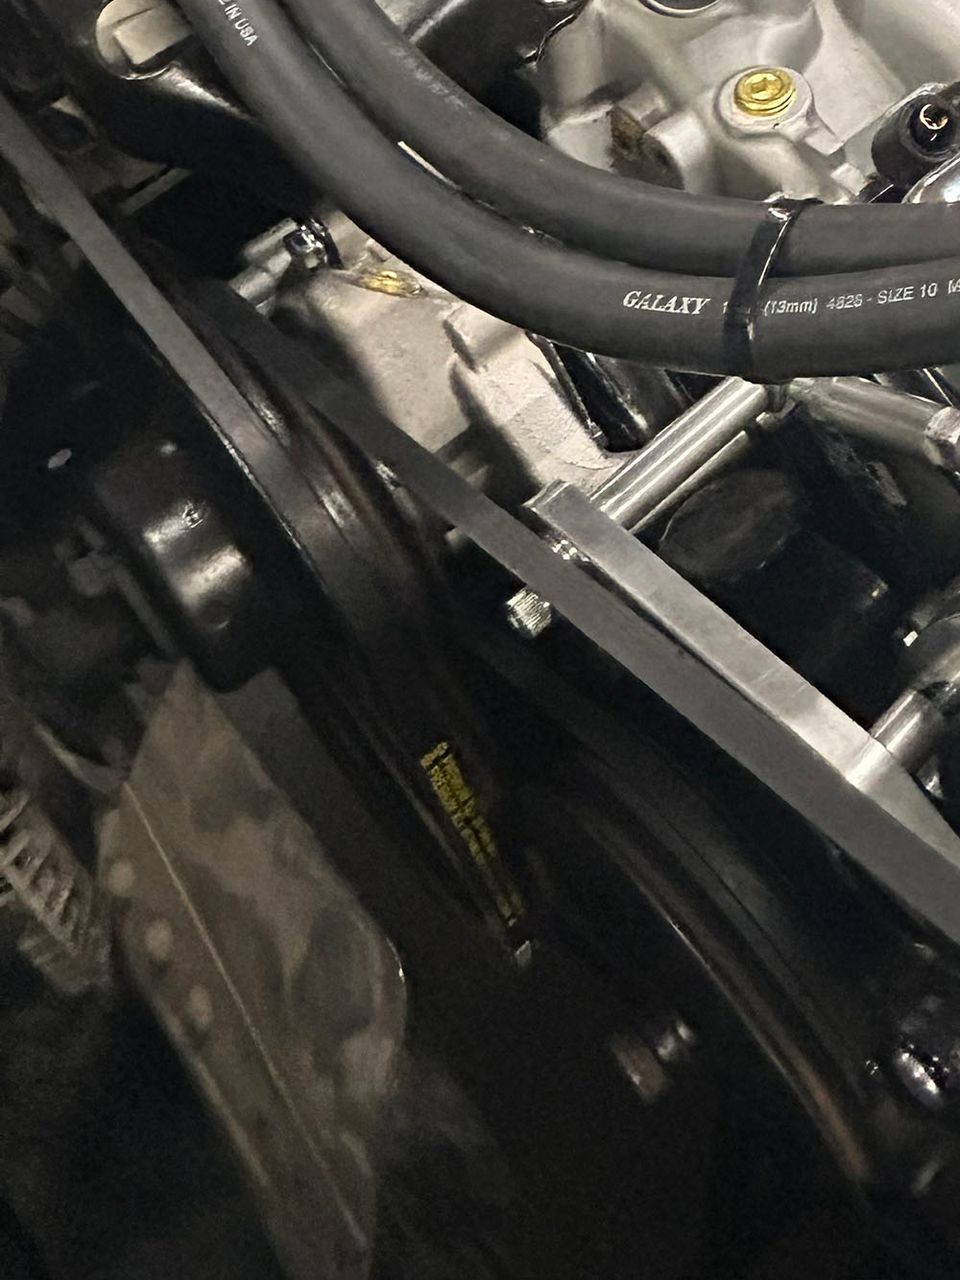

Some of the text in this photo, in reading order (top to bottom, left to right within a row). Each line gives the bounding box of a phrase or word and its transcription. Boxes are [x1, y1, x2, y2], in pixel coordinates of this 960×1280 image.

[223, 3, 244, 22] IN
[234, 17, 259, 47] USA
[622, 290, 711, 315] GALAXY
[764, 298, 818, 317] (13mm)
[877, 286, 915, 304] SIZE
[919, 282, 939, 298] 10
